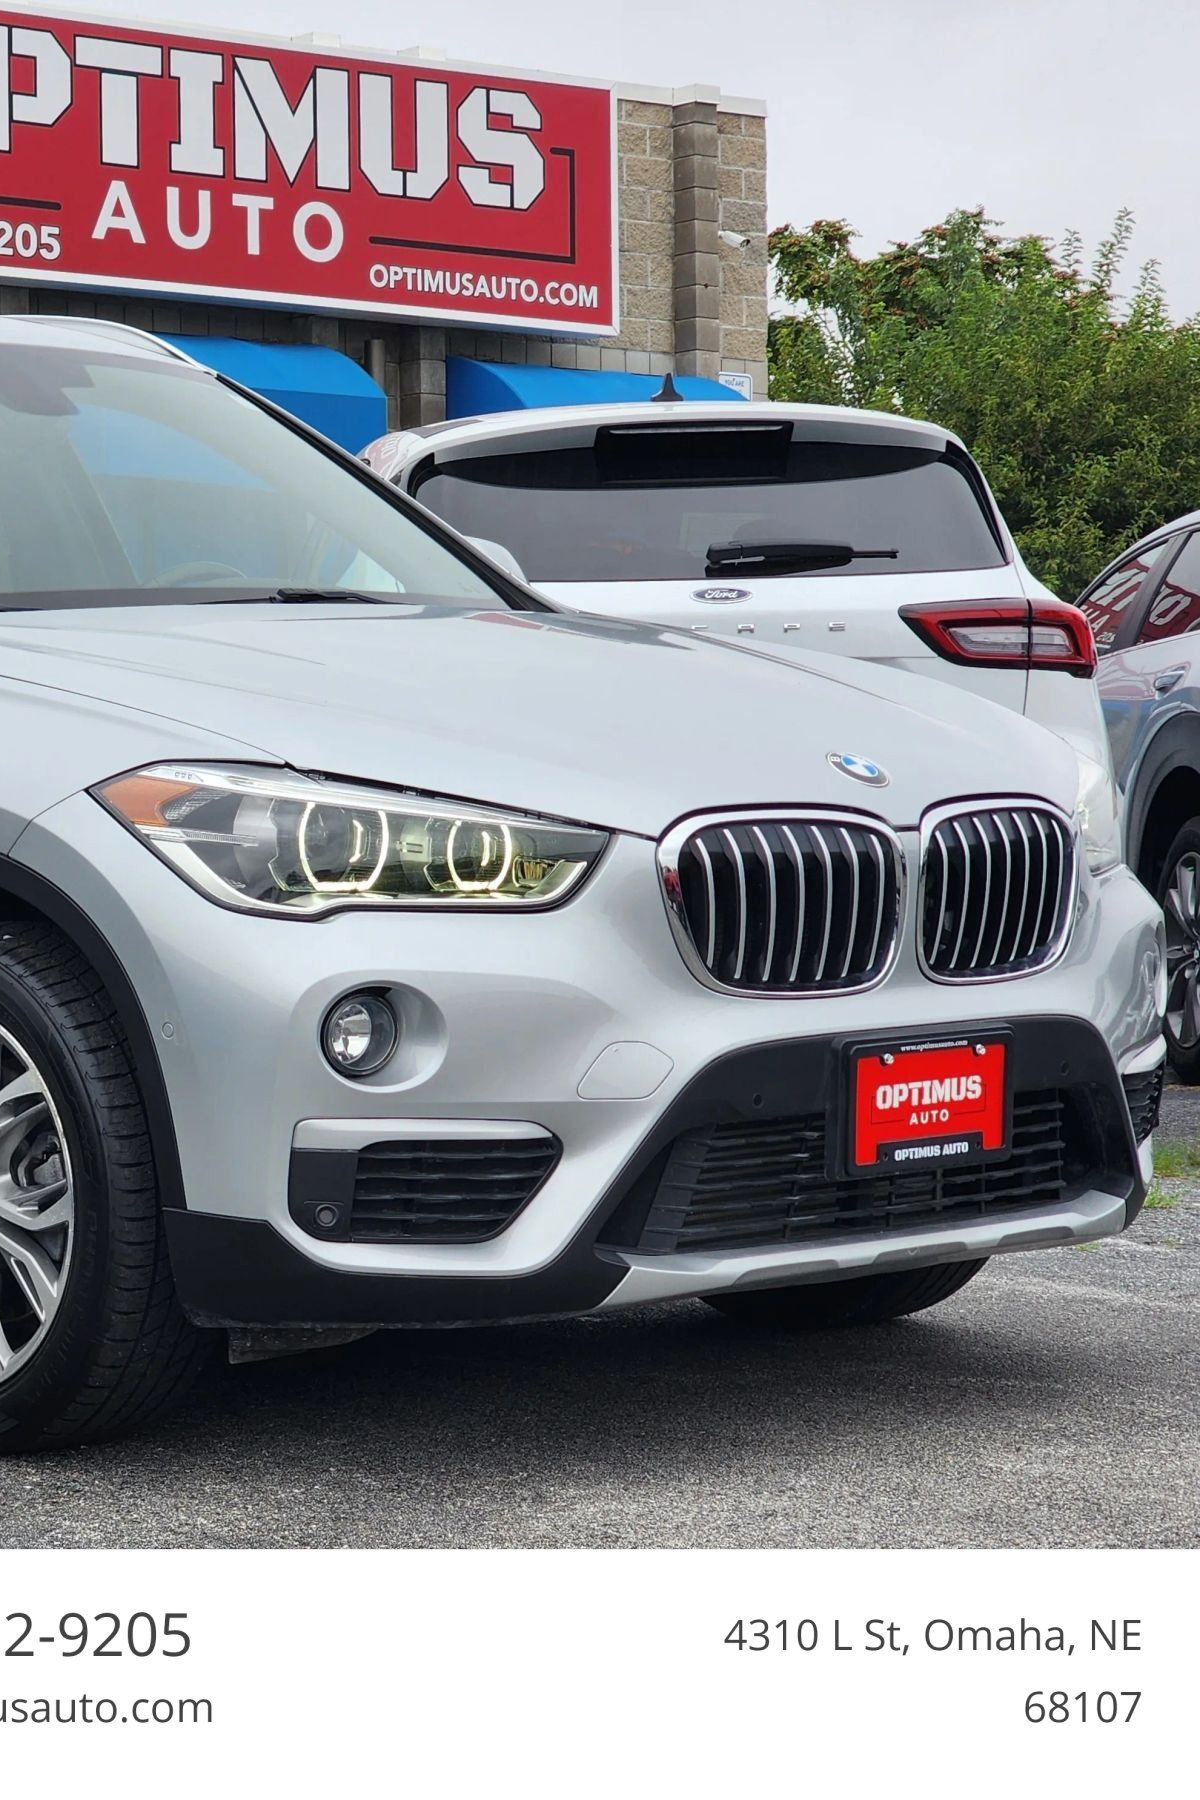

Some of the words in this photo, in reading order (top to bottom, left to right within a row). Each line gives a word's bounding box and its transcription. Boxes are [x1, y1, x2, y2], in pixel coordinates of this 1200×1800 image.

[92, 180, 346, 264] AUTO
[368, 263, 599, 309] OPTIMUSAUTO.COM
[704, 588, 739, 599] Ford
[876, 1075, 982, 1110] OPTIMUS
[909, 1108, 950, 1126] AUTO
[894, 1144, 941, 1162] OPTIMUS
[942, 1141, 969, 1155] AUTO
